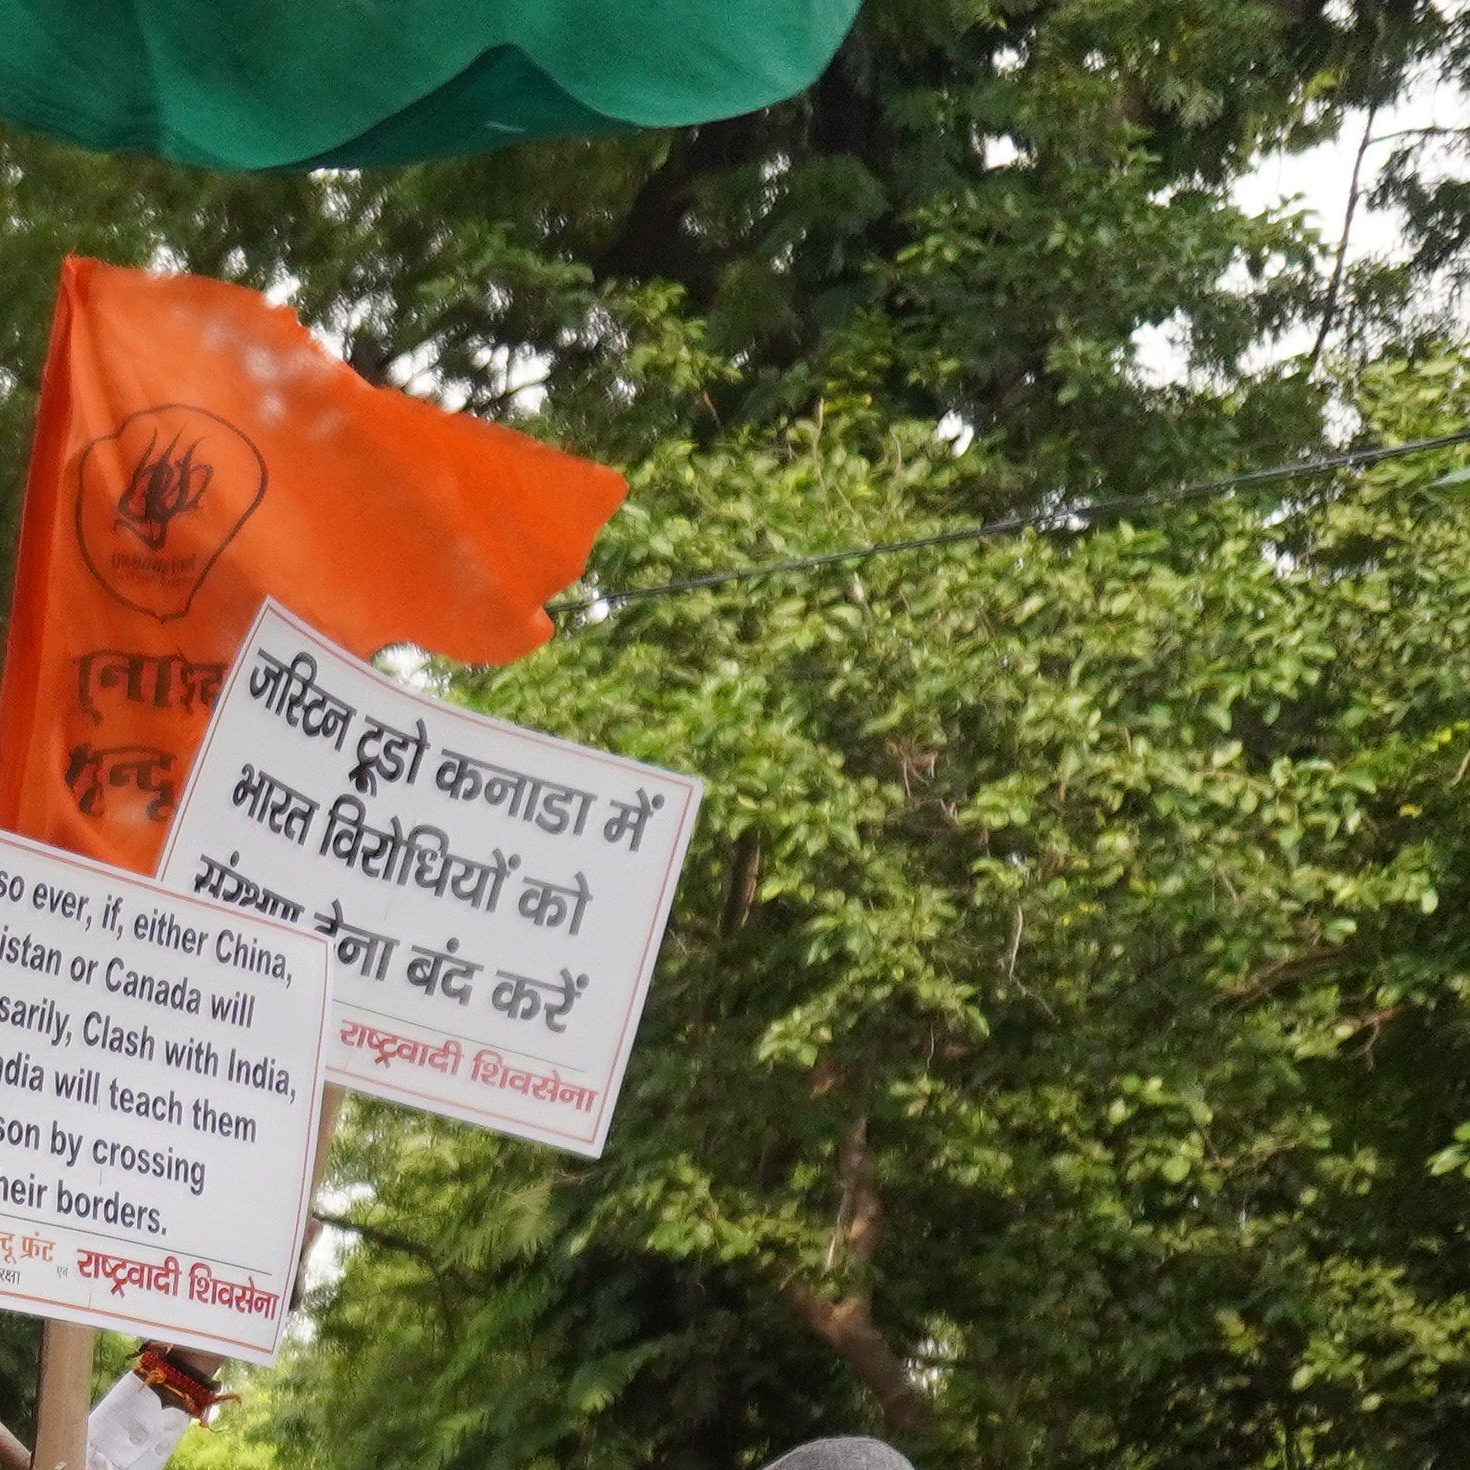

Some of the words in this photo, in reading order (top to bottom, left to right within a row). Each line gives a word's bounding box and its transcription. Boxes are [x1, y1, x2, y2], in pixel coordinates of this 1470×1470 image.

[248, 646, 359, 752] जस्टिन
[434, 747, 600, 837] कनाडा
[602, 786, 667, 854] में
[231, 762, 322, 848] भारत
[318, 793, 522, 915] विरोधियों
[517, 870, 595, 937] को
[31, 881, 94, 933] ever,
[99, 893, 125, 940] if,
[132, 907, 210, 959] either
[213, 927, 294, 990] China,
[69, 952, 100, 986] or
[103, 954, 202, 1018] Canada
[210, 991, 257, 1030] will
[405, 936, 486, 1007] बंद
[490, 967, 591, 1035] करें
[81, 1009, 157, 1063] Clash
[163, 1037, 220, 1079] with
[226, 1045, 298, 1104] India,
[470, 1048, 601, 1115] शिवसेना
[54, 1066, 101, 1103] will
[108, 1075, 184, 1127] teach
[191, 1099, 258, 1145] them
[49, 1119, 85, 1169] by
[91, 1135, 207, 1198] crossing
[55, 1177, 169, 1239] borders.
[187, 1261, 282, 1322] शिवसेना
